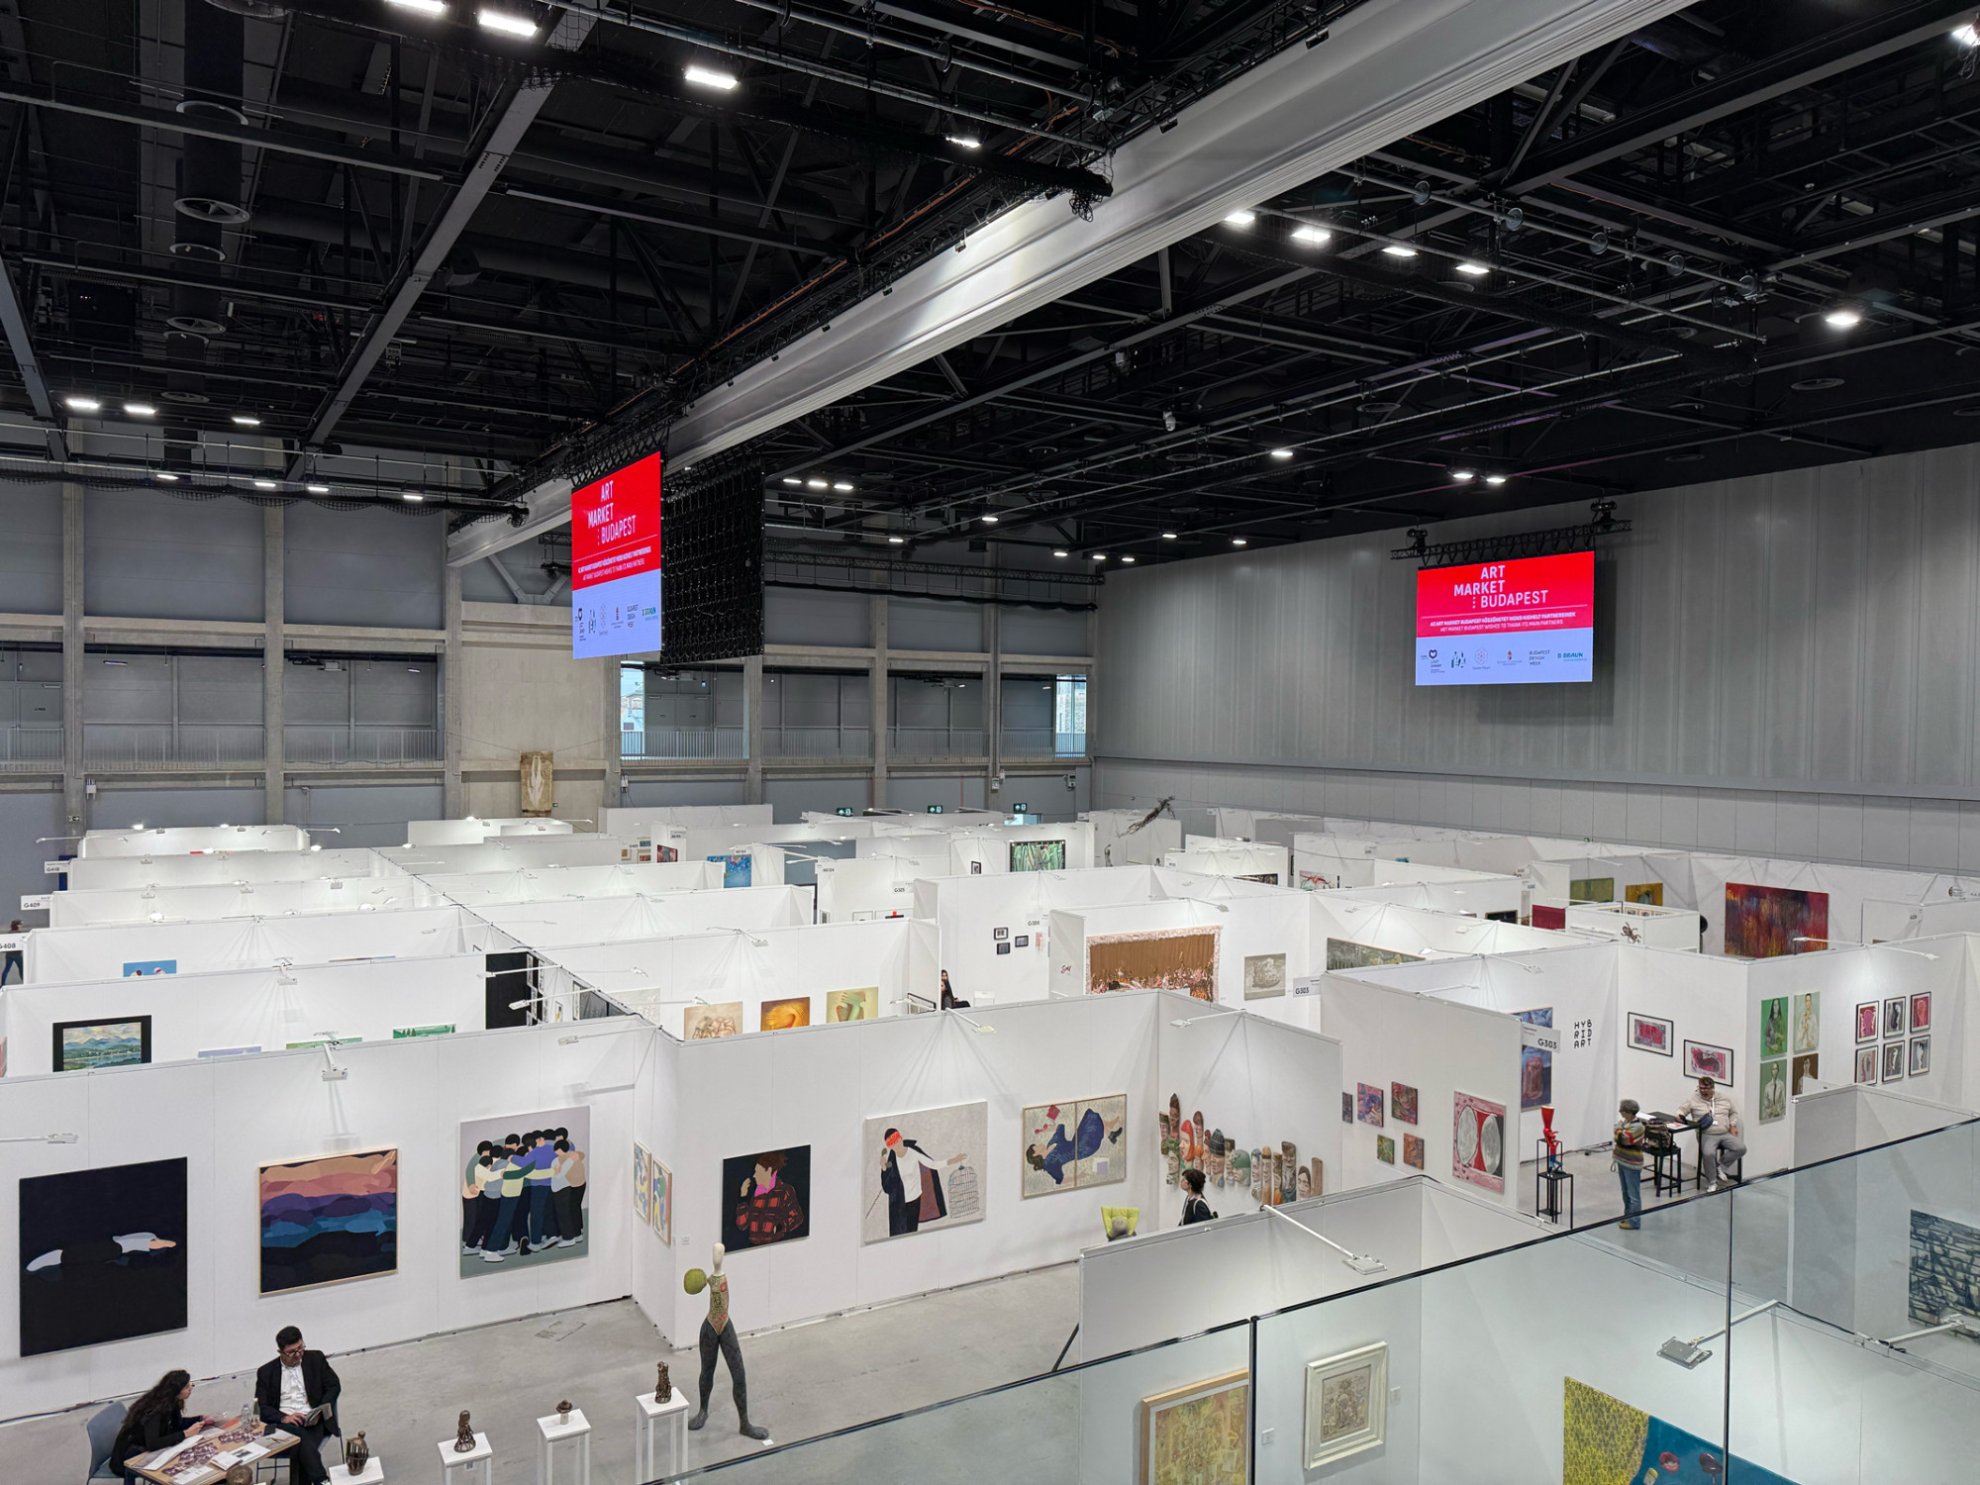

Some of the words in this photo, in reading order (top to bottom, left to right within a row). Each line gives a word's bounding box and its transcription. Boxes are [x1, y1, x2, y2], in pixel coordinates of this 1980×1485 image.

[601, 480, 614, 502] ART
[588, 502, 614, 529] MARKET
[601, 514, 637, 545] BUDAPEST
[1480, 565, 1505, 579] ART
[1454, 580, 1505, 597] MARKET
[1480, 590, 1549, 608] BUDAPEST
[1295, 987, 1310, 995] G303
[1573, 1019, 1592, 1030] HYB
[1573, 1028, 1592, 1039] RID
[1537, 1038, 1557, 1049] G303
[1573, 1038, 1592, 1049] ART
